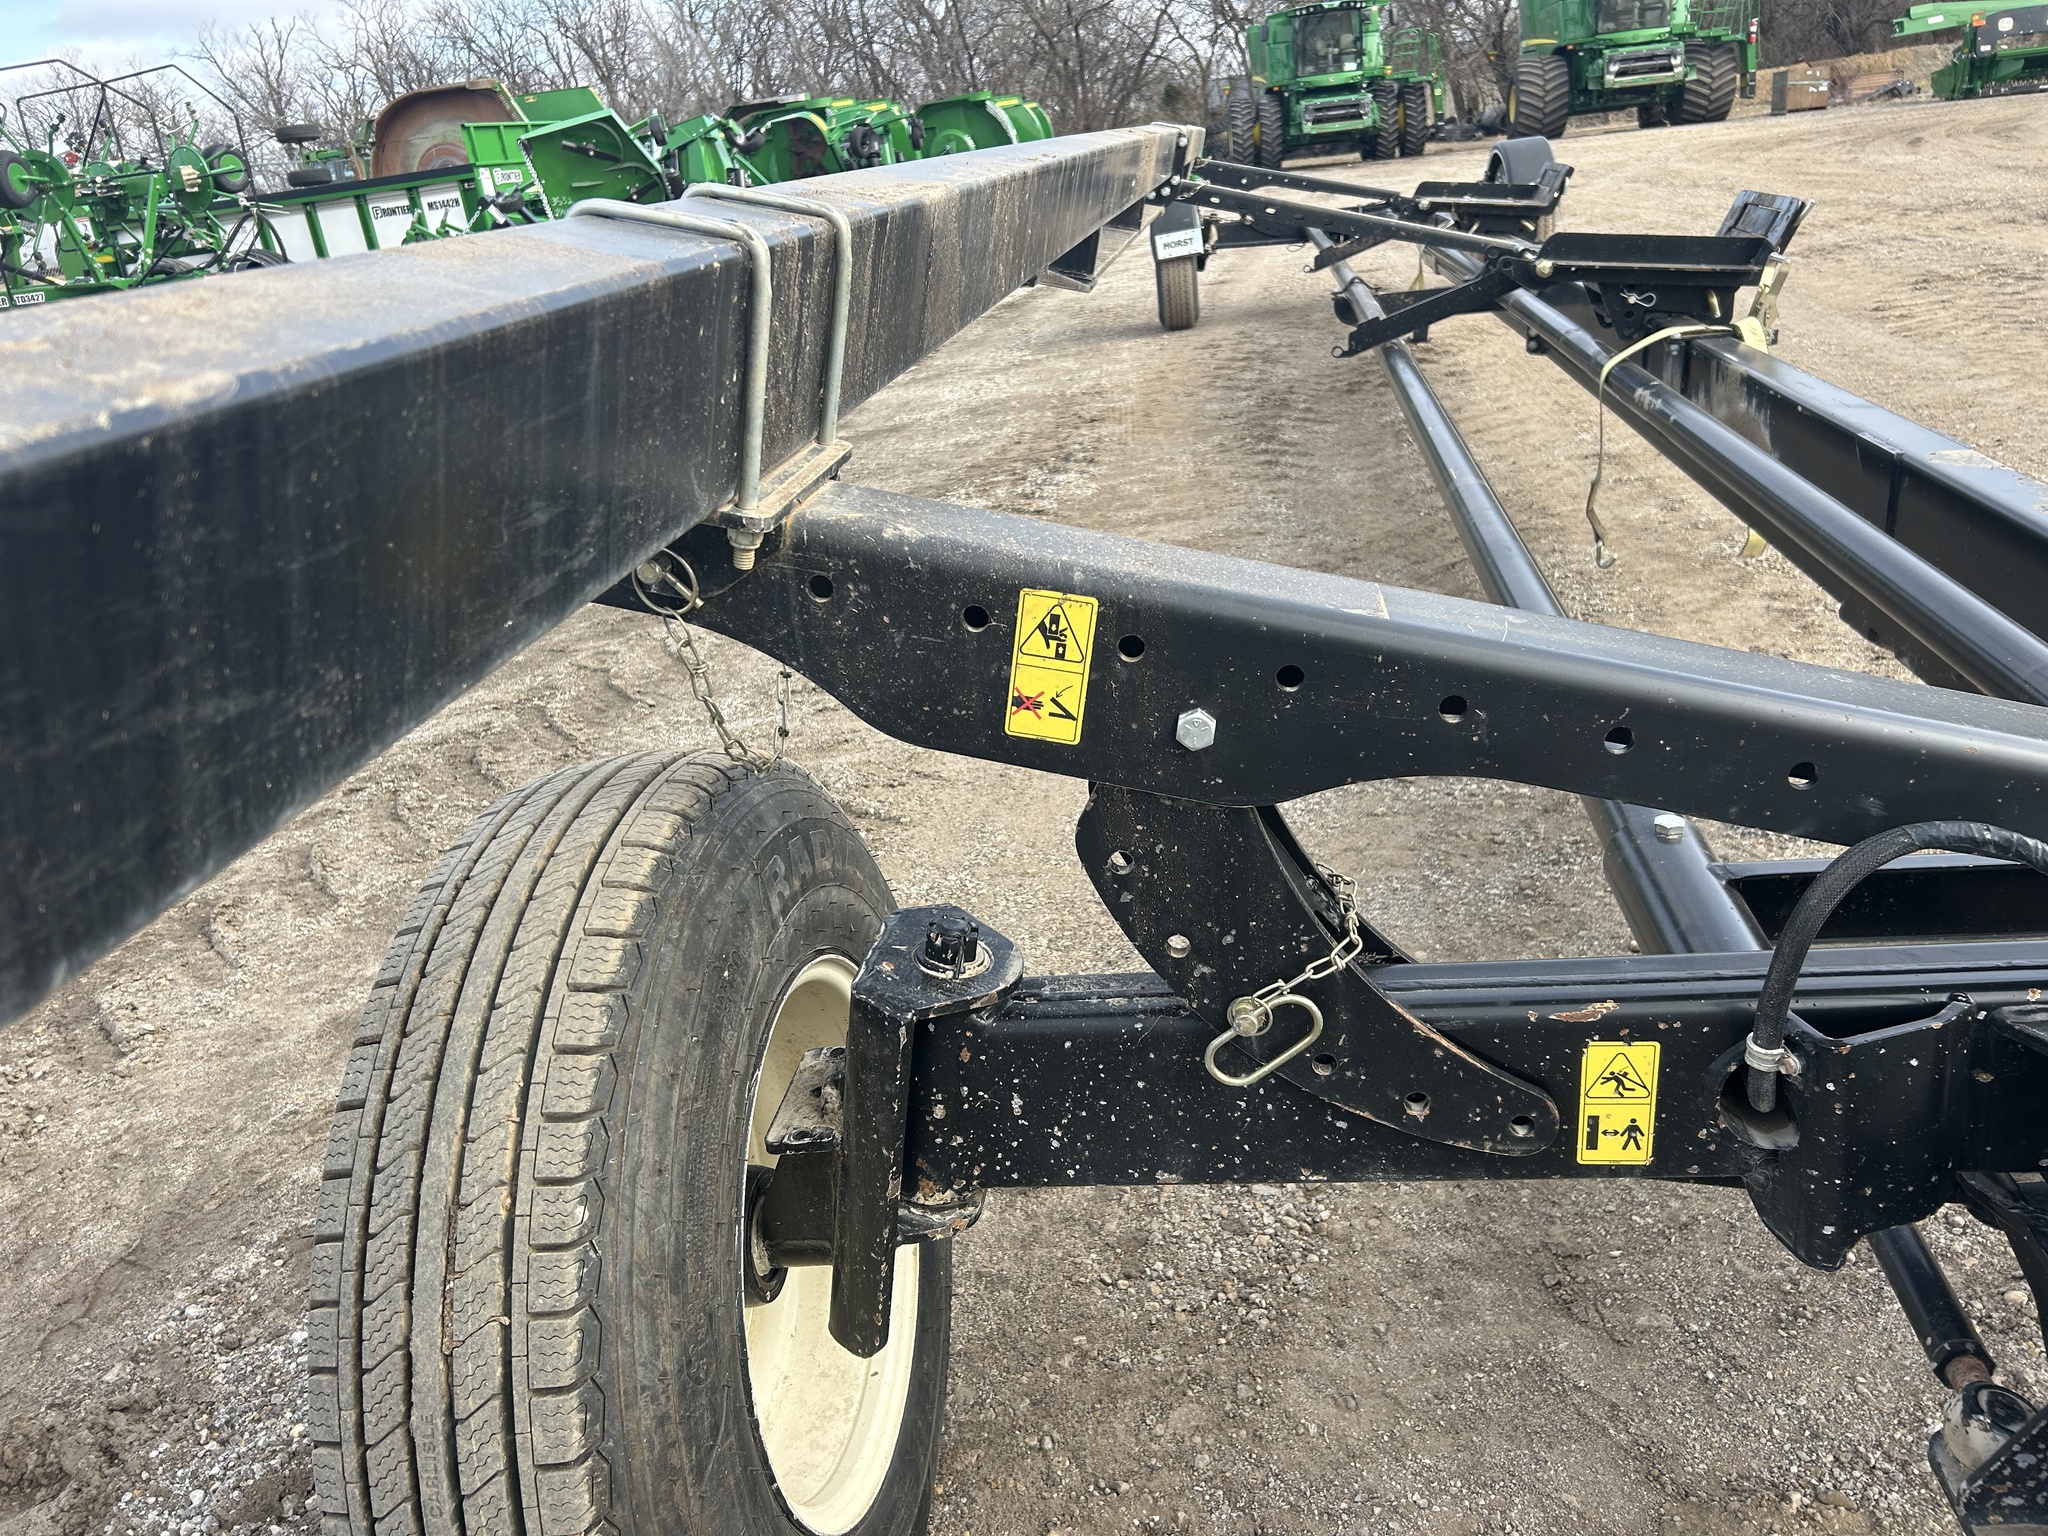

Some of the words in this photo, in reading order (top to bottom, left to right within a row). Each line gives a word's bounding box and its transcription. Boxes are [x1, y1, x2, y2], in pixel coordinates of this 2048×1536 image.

[427, 198, 460, 212] MS1442H
[1163, 238, 1194, 250] HORST
[15, 293, 45, 304] TD3427
[420, 1413, 443, 1520] CARLISLE
